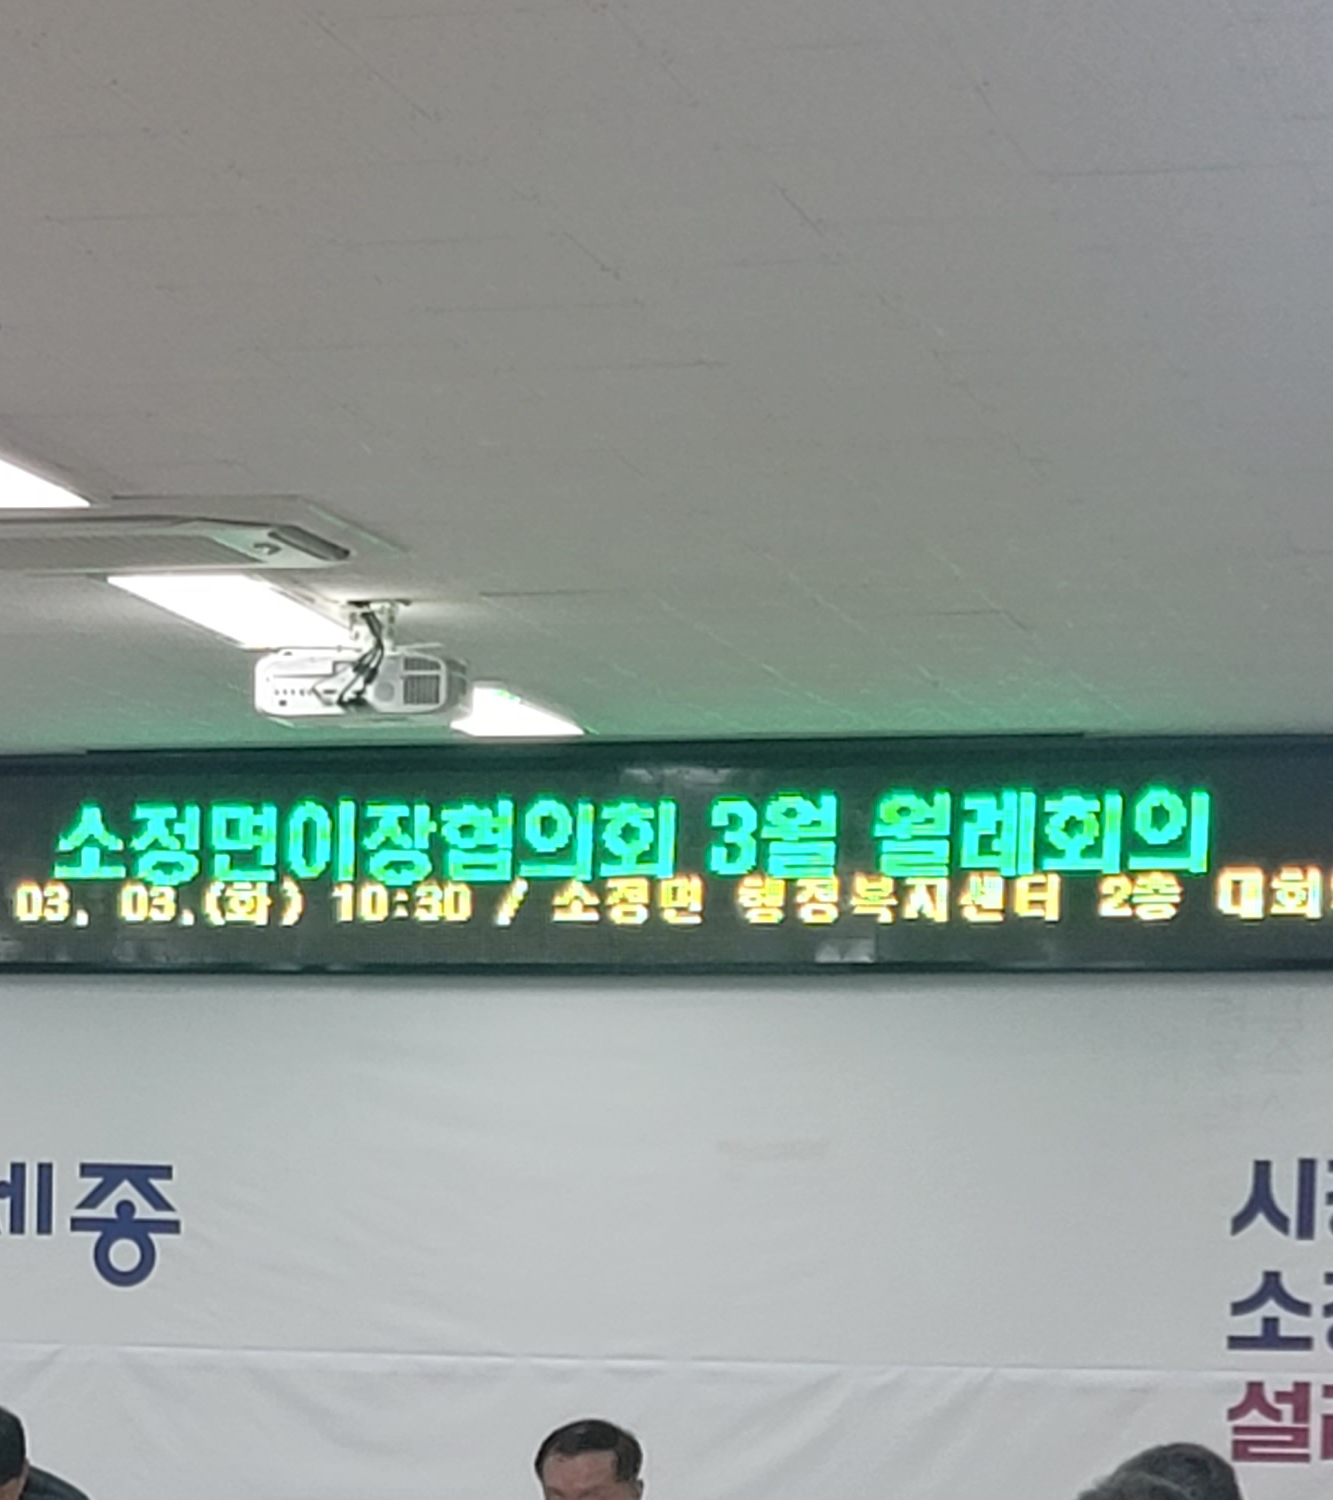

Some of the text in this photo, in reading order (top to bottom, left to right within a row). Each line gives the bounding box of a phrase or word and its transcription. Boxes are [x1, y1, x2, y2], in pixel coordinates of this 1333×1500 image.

[53, 786, 1211, 888] 소정면이장협의회 3월 월레회의
[331, 880, 474, 924] 10:30
[551, 875, 705, 926] 소정면
[735, 872, 1063, 924] 행정복지센터
[1096, 870, 1184, 922] 2층
[1215, 865, 1333, 922] 대회
[1229, 1156, 1333, 1242] 시
[1226, 1269, 1333, 1352] 소
[1226, 1379, 1333, 1464] 설
